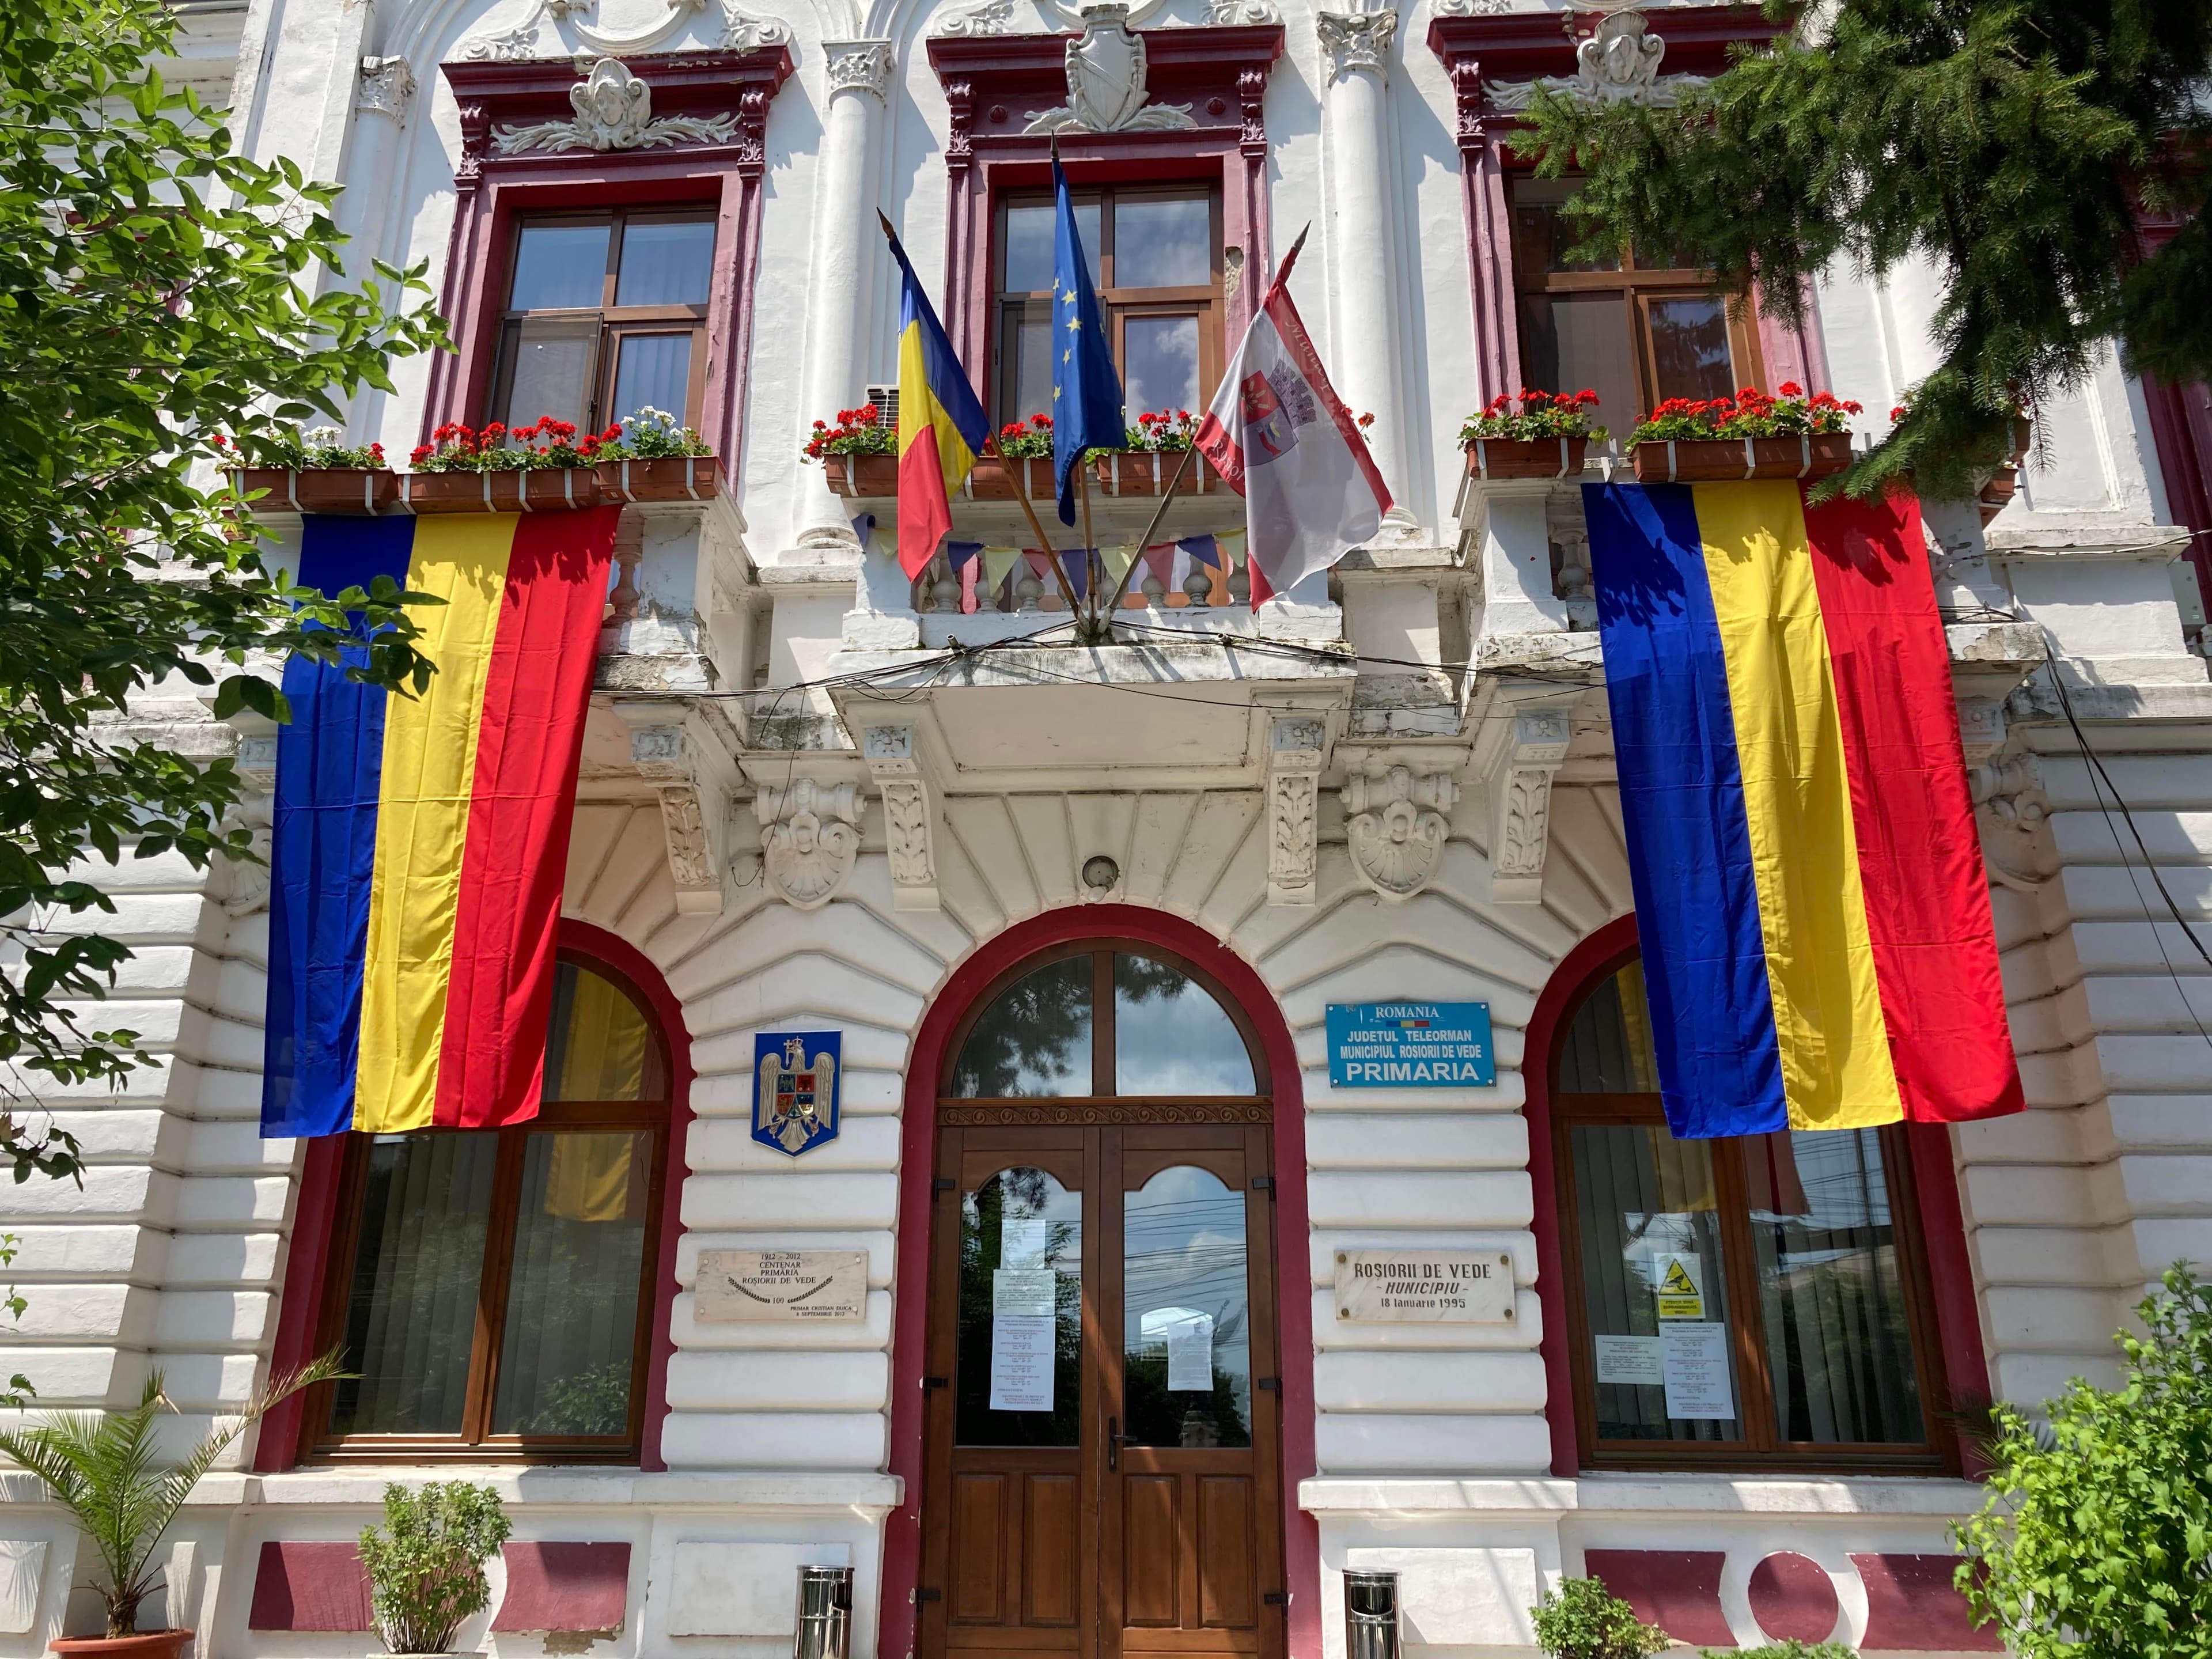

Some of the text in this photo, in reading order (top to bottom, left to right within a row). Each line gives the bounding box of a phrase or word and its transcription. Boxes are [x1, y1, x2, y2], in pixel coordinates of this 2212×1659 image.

[1406, 1030, 1472, 1041] TELEORMAN
[1340, 1045, 1395, 1059] MUNICIPIUL
[1442, 1045, 1455, 1058] DE
[1456, 1044, 1482, 1058] VEDE
[1423, 1264, 1442, 1278] DE
[1449, 1264, 1491, 1278] VEDE
[1385, 1282, 1460, 1294] MUNICIPIU
[1381, 1298, 1466, 1308] 18 Ianuarie 1995
